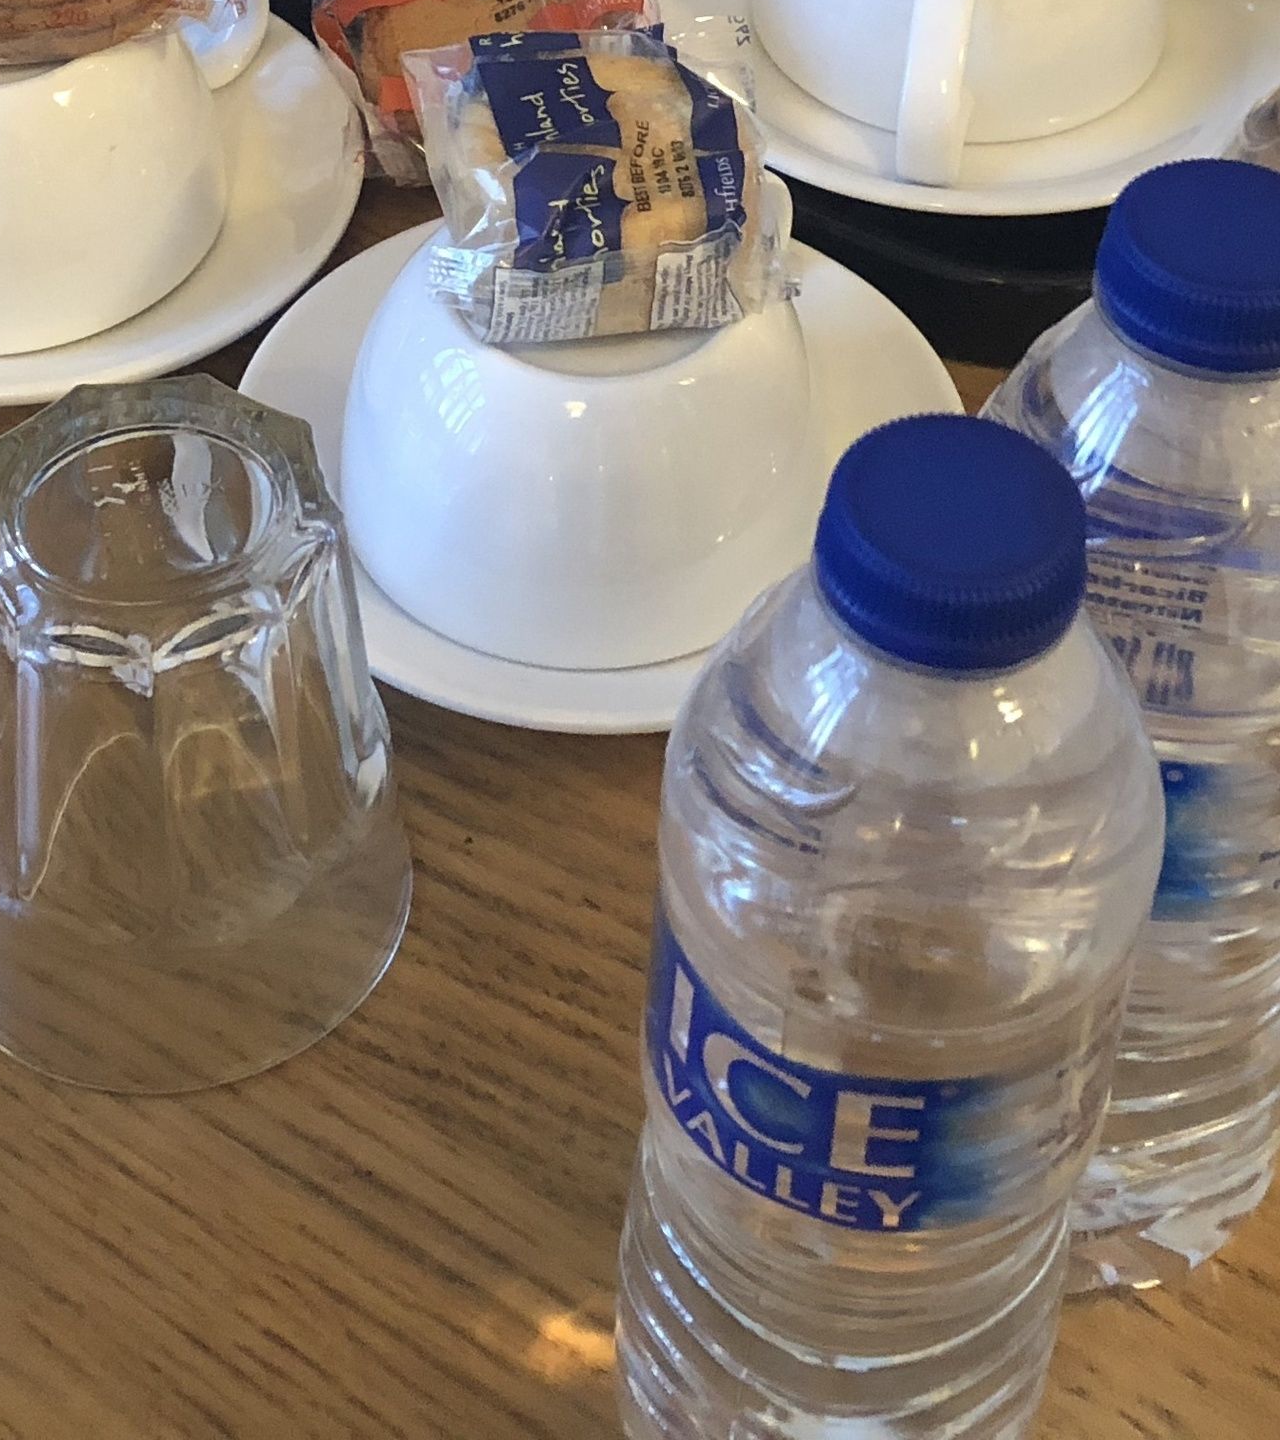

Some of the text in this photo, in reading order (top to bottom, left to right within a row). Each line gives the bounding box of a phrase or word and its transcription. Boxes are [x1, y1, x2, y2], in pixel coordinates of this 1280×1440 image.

[629, 120, 652, 212] BEST BEFORE
[676, 161, 690, 177] 2
[669, 962, 925, 1179] ICE
[662, 1050, 921, 1229] VALLEY
